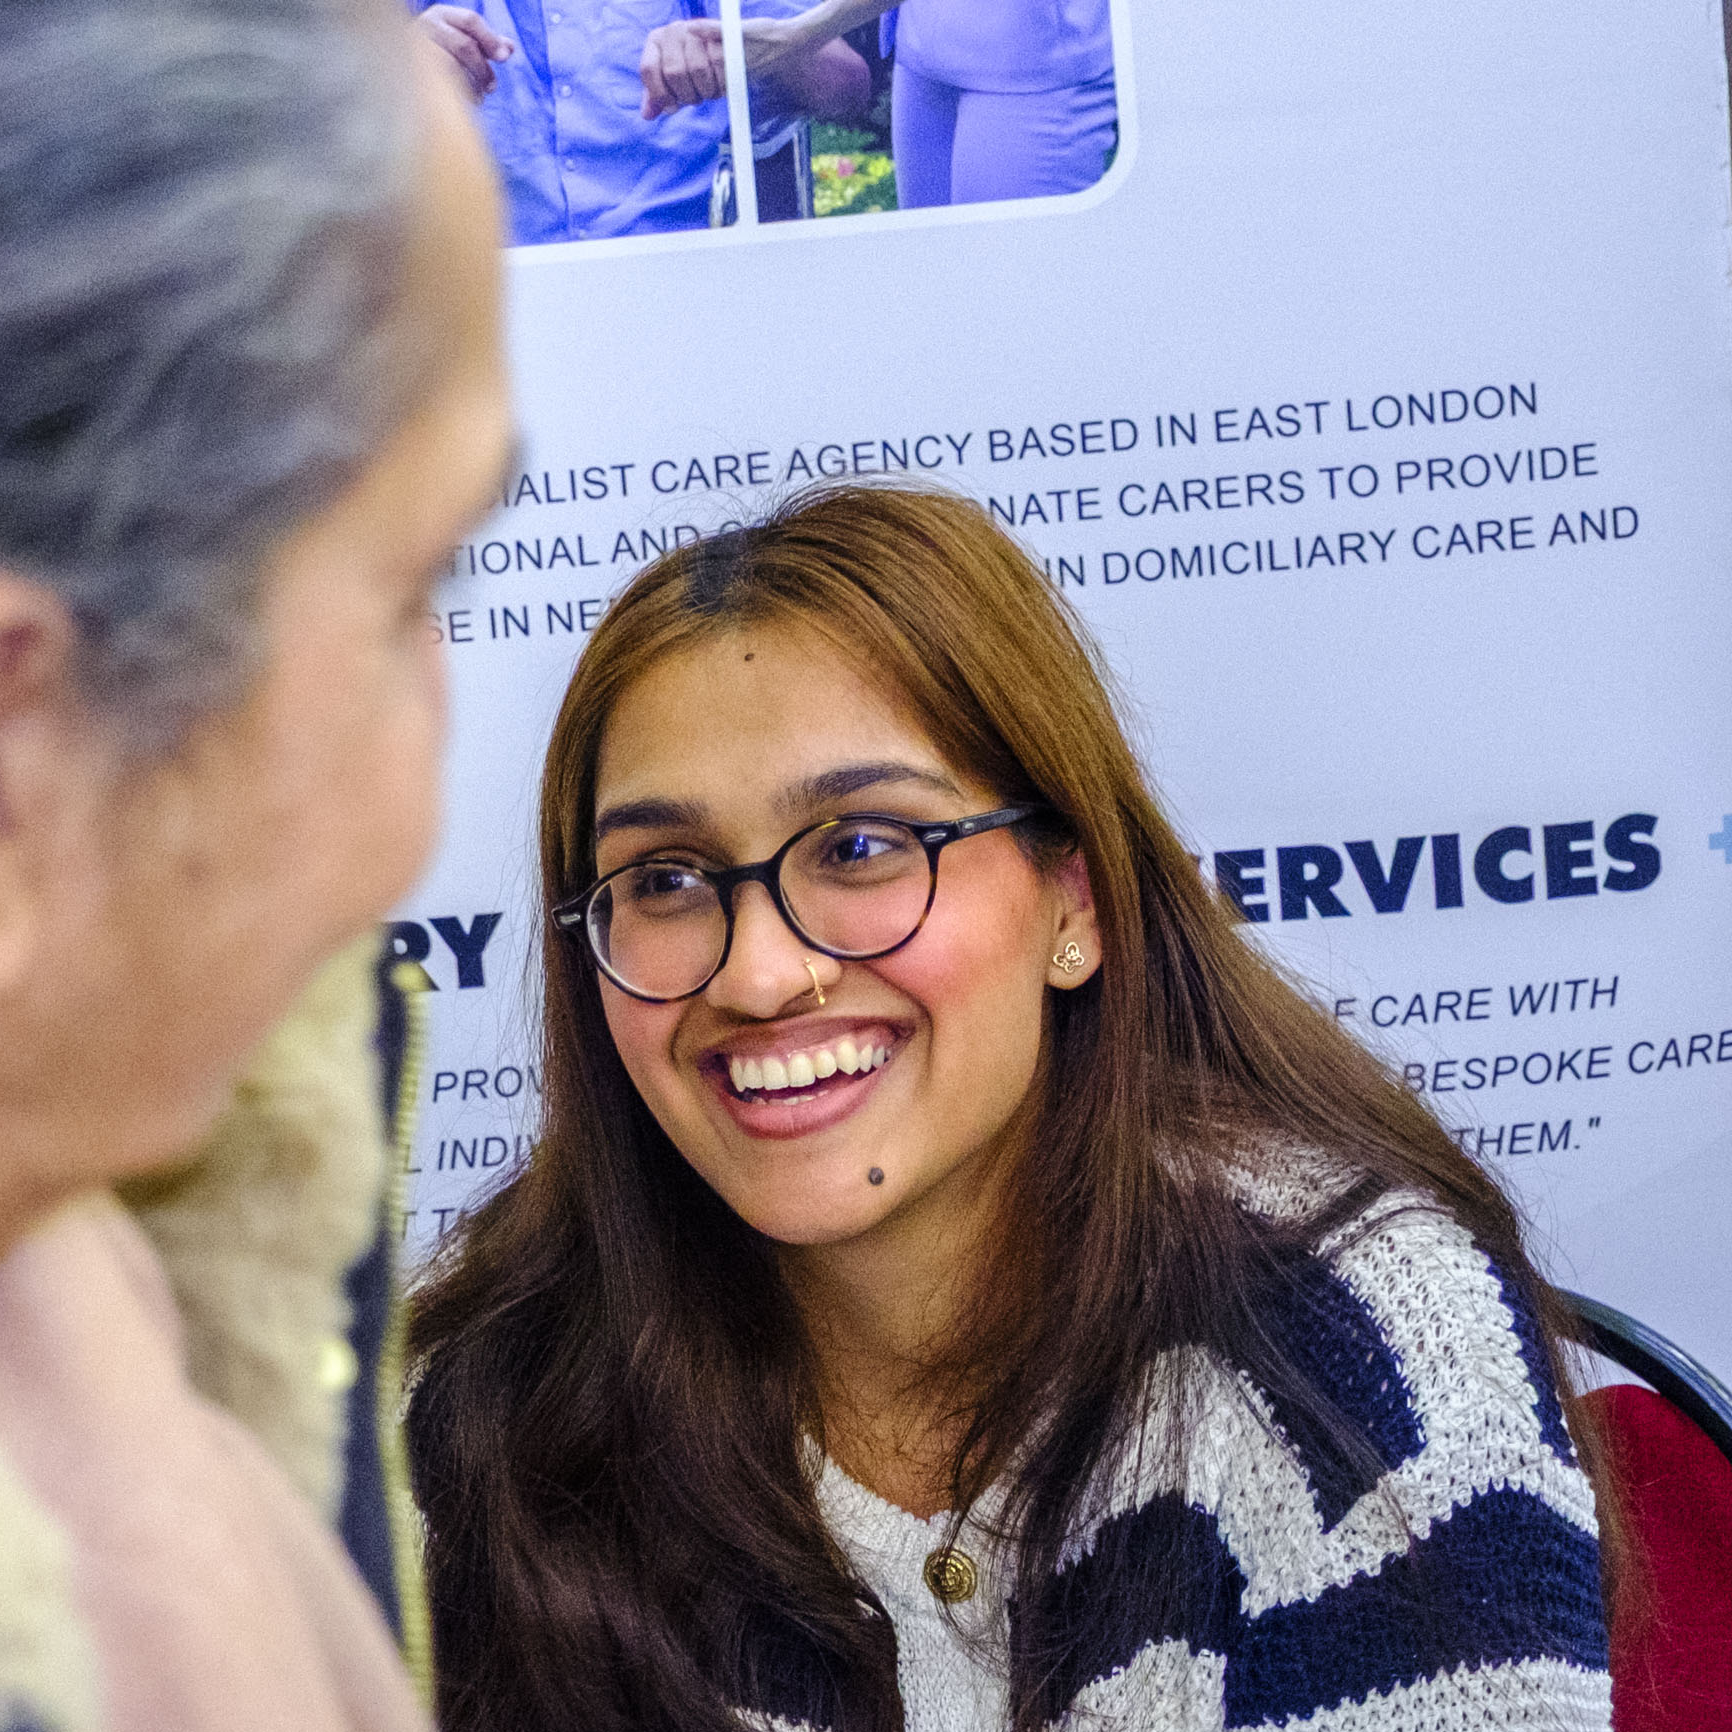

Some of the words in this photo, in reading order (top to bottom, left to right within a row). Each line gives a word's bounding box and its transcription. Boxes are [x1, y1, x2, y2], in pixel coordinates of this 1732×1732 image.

[651, 450, 772, 494] CARE
[786, 432, 974, 482] AGENCY
[988, 416, 1139, 463] BASED
[1155, 412, 1198, 449] IN
[1214, 400, 1332, 444] EAST
[1346, 381, 1539, 432] LONDON
[989, 488, 1103, 528] NATE
[1118, 469, 1307, 518] CARERS
[1319, 464, 1381, 501] TO
[1395, 443, 1601, 495] PROVIDE
[489, 605, 532, 640] IN
[546, 598, 612, 635] NE
[1101, 529, 1399, 586] DOMICILIARY
[1411, 516, 1537, 562] CARE
[1546, 505, 1641, 547] AND
[1370, 987, 1494, 1029] CARE
[1508, 975, 1621, 1018] WITH
[1403, 1045, 1614, 1094] BESPOKE
[436, 1133, 534, 1172] INDI
